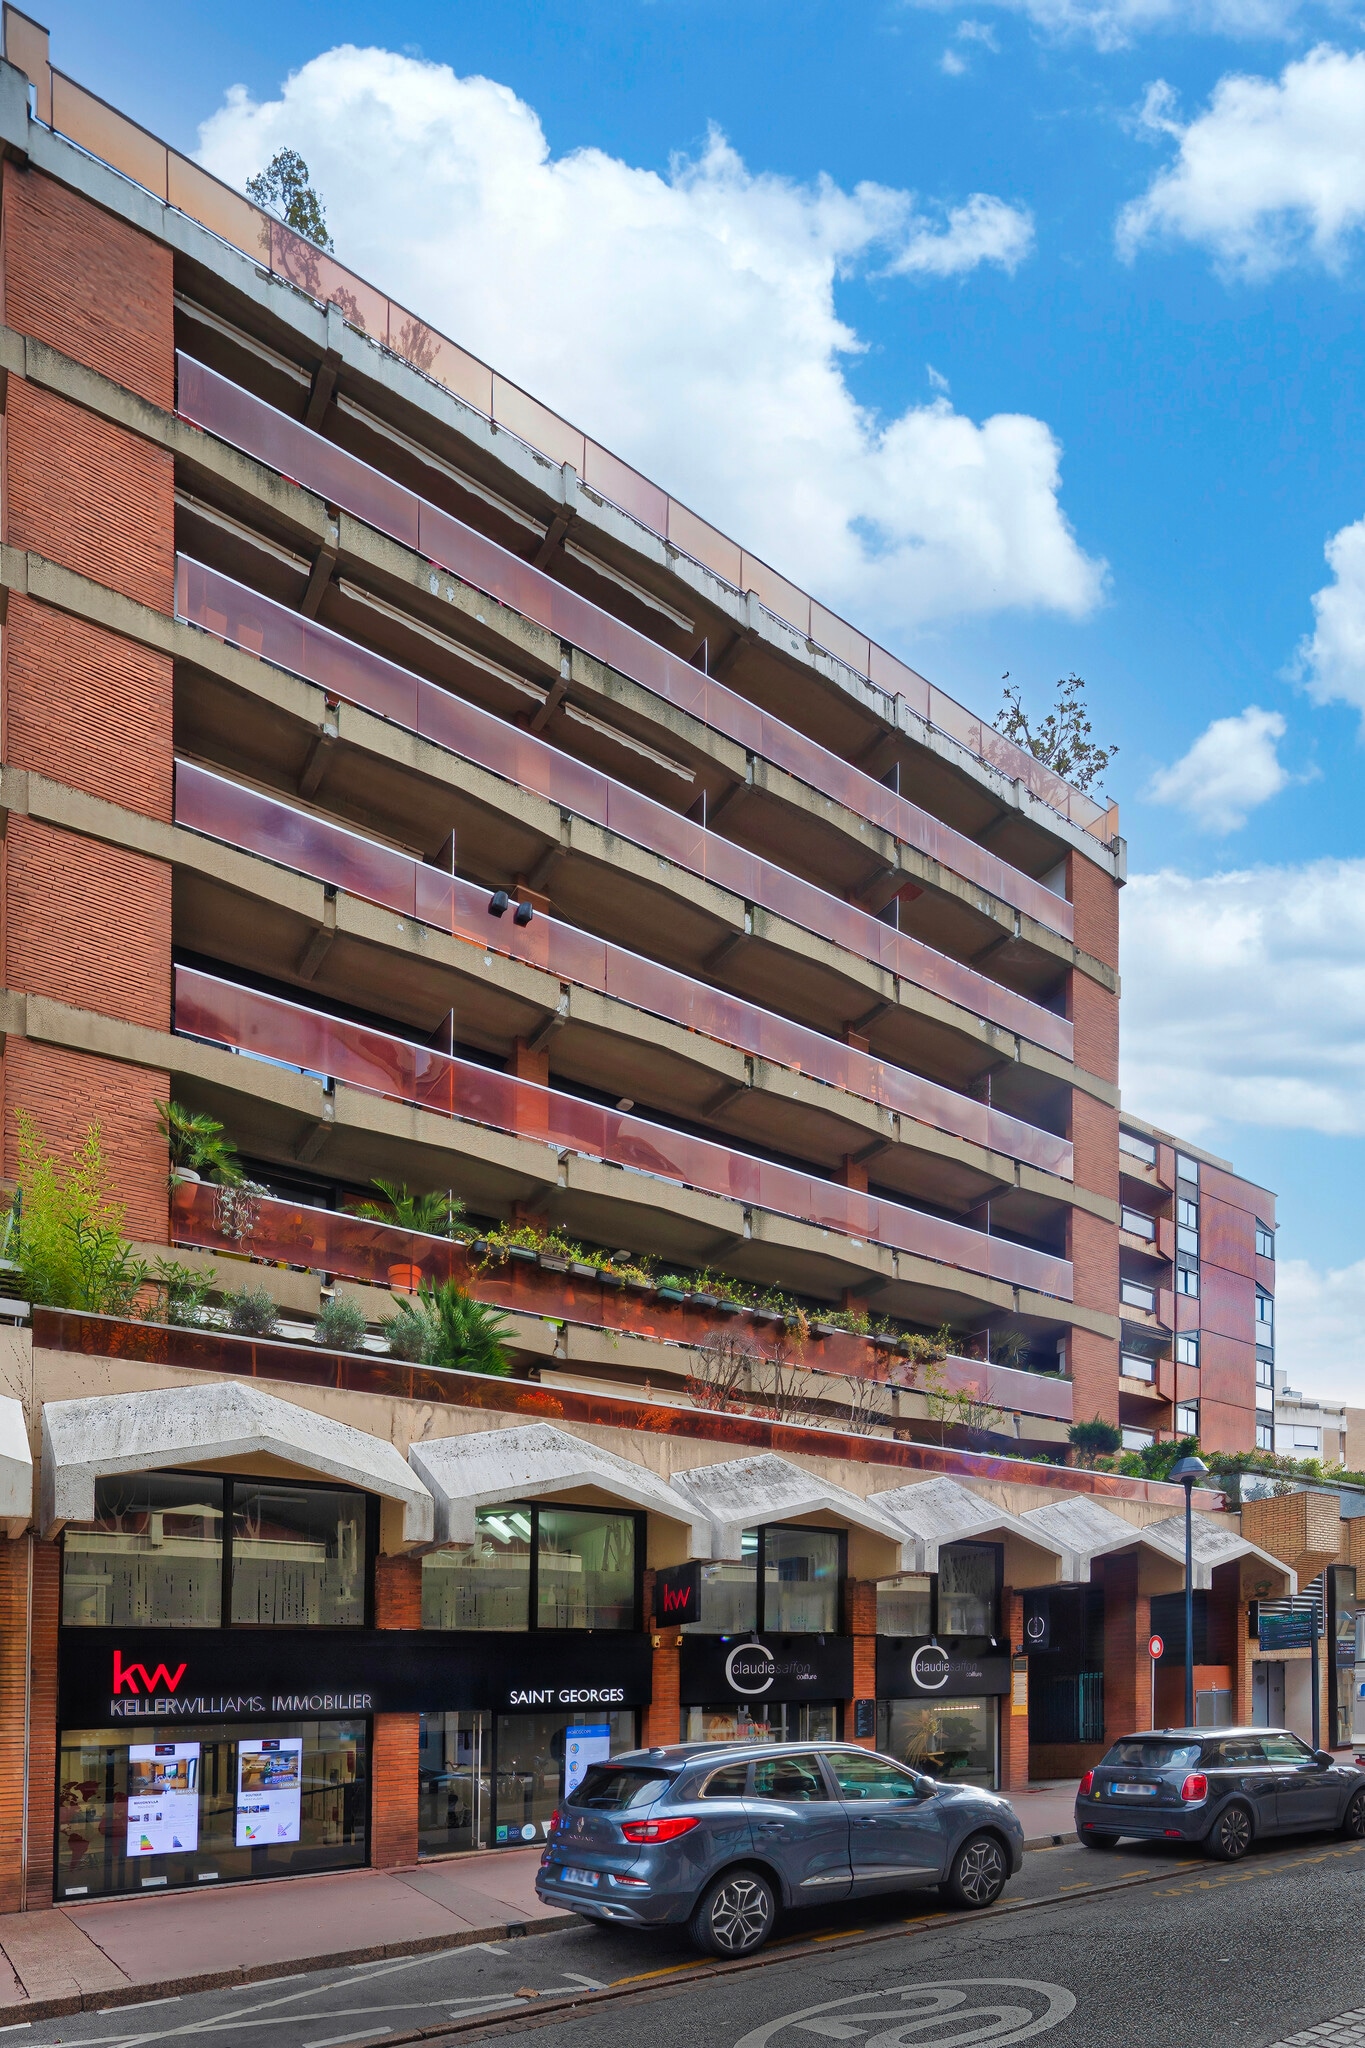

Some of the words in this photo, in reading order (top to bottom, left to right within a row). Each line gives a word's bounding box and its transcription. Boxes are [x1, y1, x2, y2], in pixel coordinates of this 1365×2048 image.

[663, 1583, 692, 1612] kw
[113, 1650, 187, 1694] kw
[271, 1693, 372, 1713] IMMOBILIER
[509, 1689, 555, 1705] SAINT
[558, 1688, 624, 1704] GEORGES
